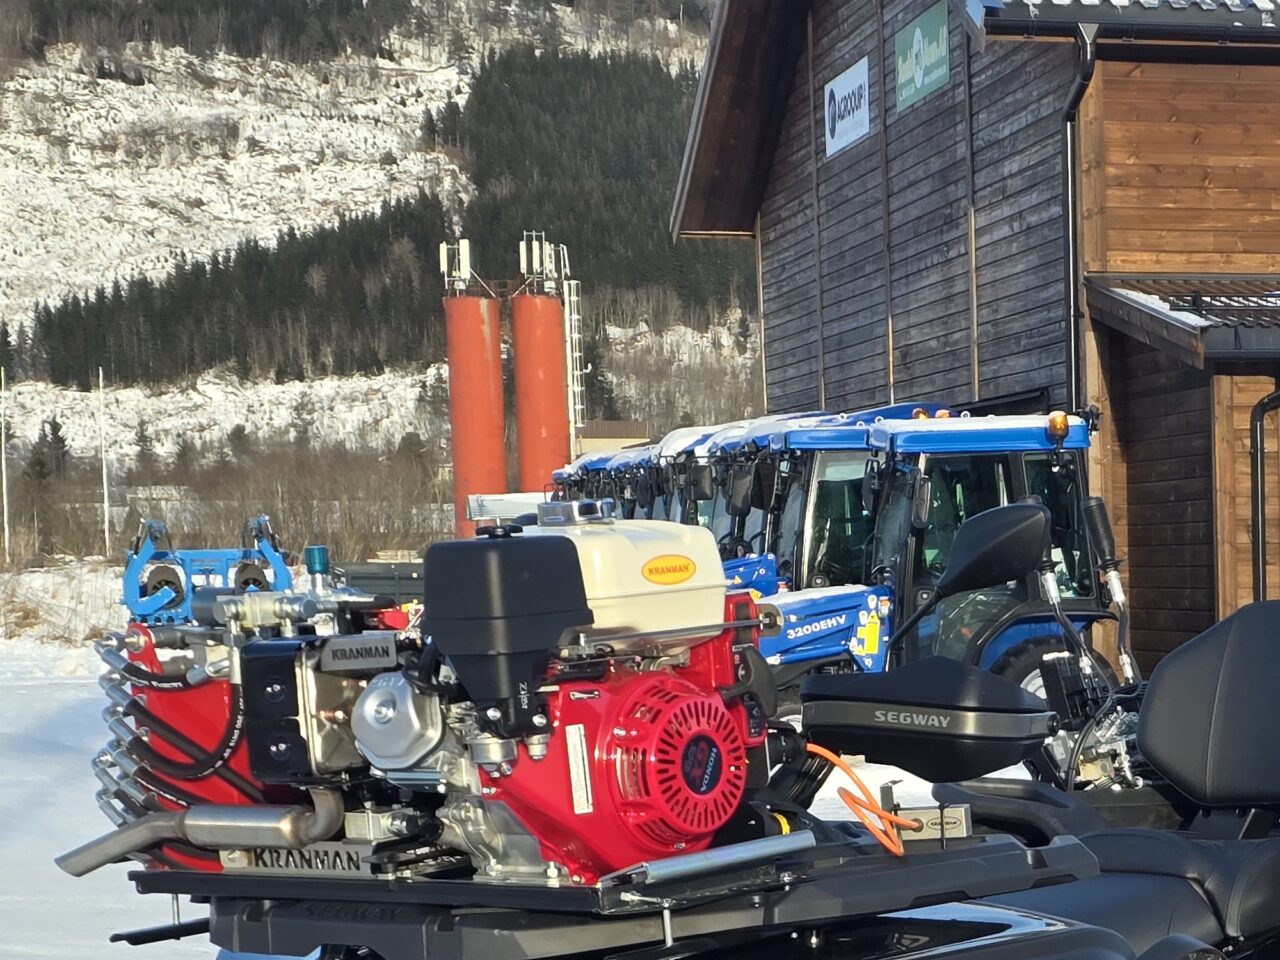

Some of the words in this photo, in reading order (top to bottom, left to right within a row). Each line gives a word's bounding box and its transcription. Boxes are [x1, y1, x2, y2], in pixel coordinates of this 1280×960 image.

[647, 562, 690, 576] KRANMAN
[786, 614, 847, 639] 3200EHV
[331, 646, 390, 661] KRANMAN
[874, 710, 950, 728] SEGWAY
[700, 747, 717, 792] HONDA
[253, 848, 361, 871] KRANMAN
